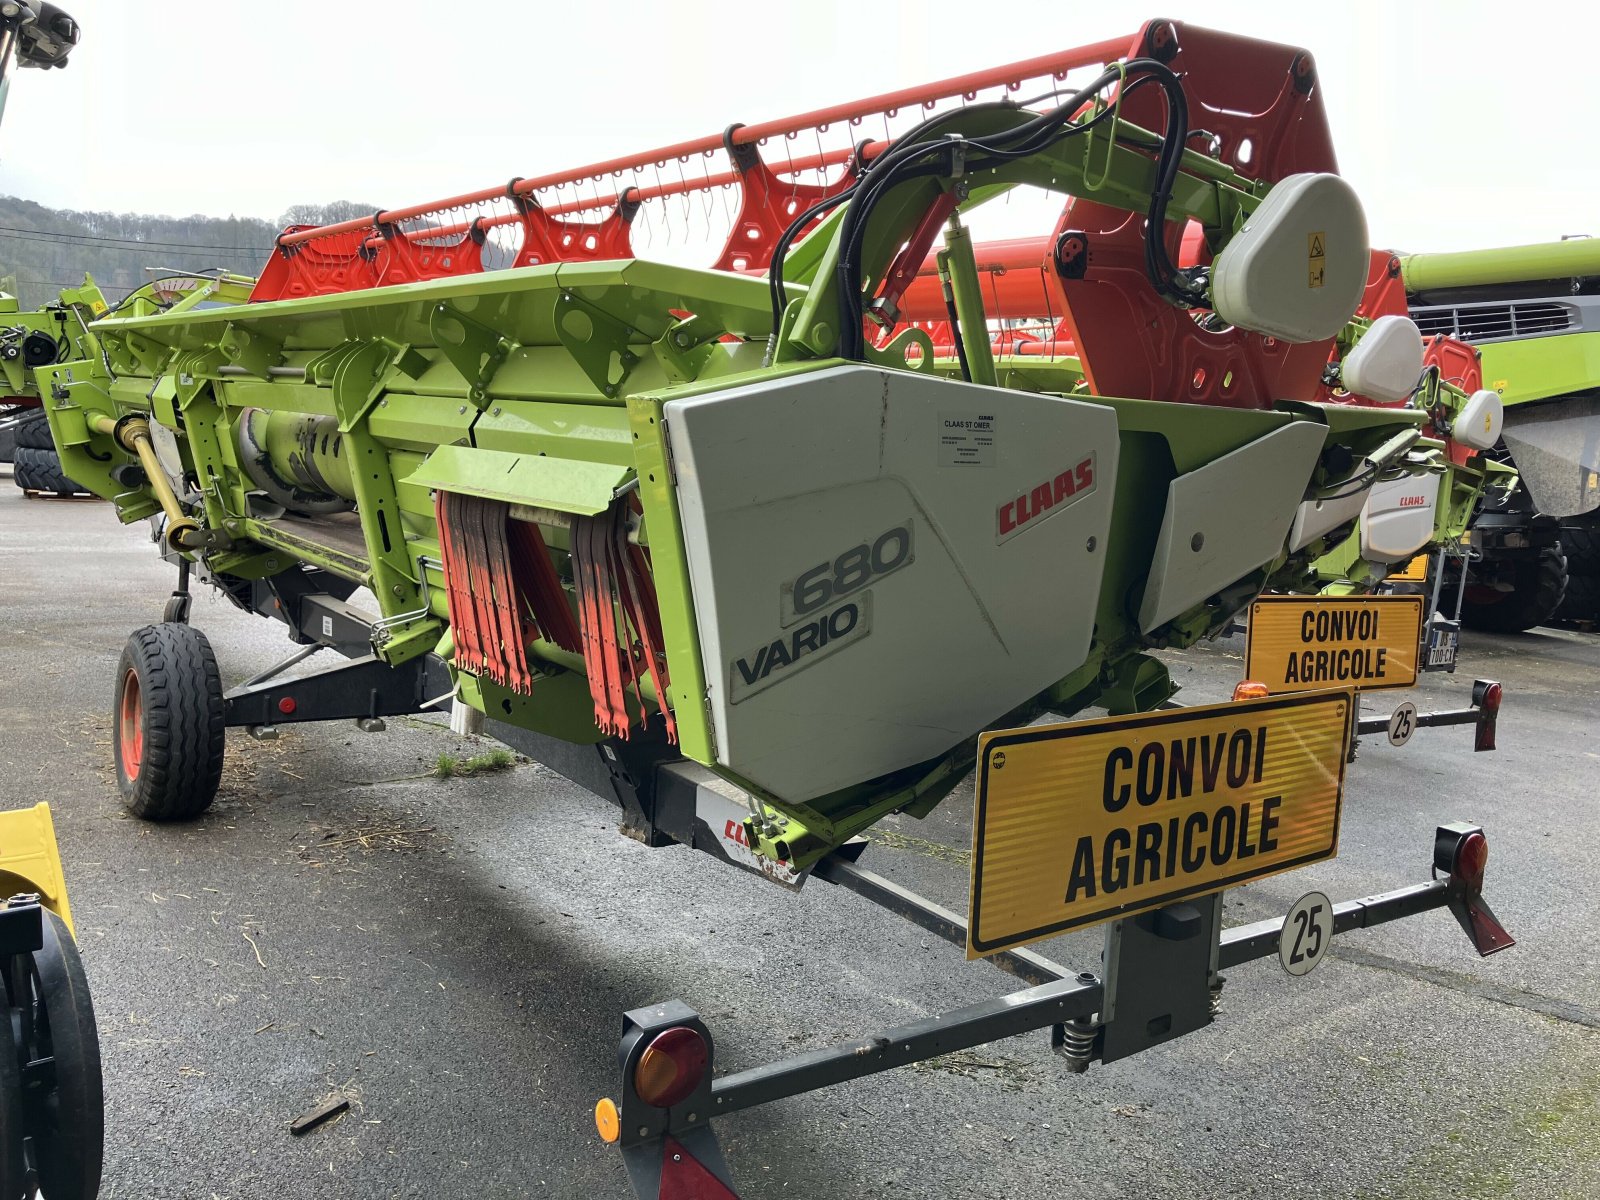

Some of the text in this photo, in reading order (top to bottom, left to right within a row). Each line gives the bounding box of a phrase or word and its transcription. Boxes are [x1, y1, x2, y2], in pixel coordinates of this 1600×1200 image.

[999, 458, 1093, 535] CLAAS
[1399, 495, 1425, 507] CLAAS
[793, 526, 910, 615] 680
[736, 603, 859, 686] VARIO
[1301, 609, 1379, 643] CONVOI
[1285, 648, 1387, 684] AGRICOLE
[1392, 709, 1412, 740] 25
[1102, 726, 1268, 813] CONVOI
[1064, 796, 1282, 904] AGRICOLE
[1290, 904, 1323, 965] 25
